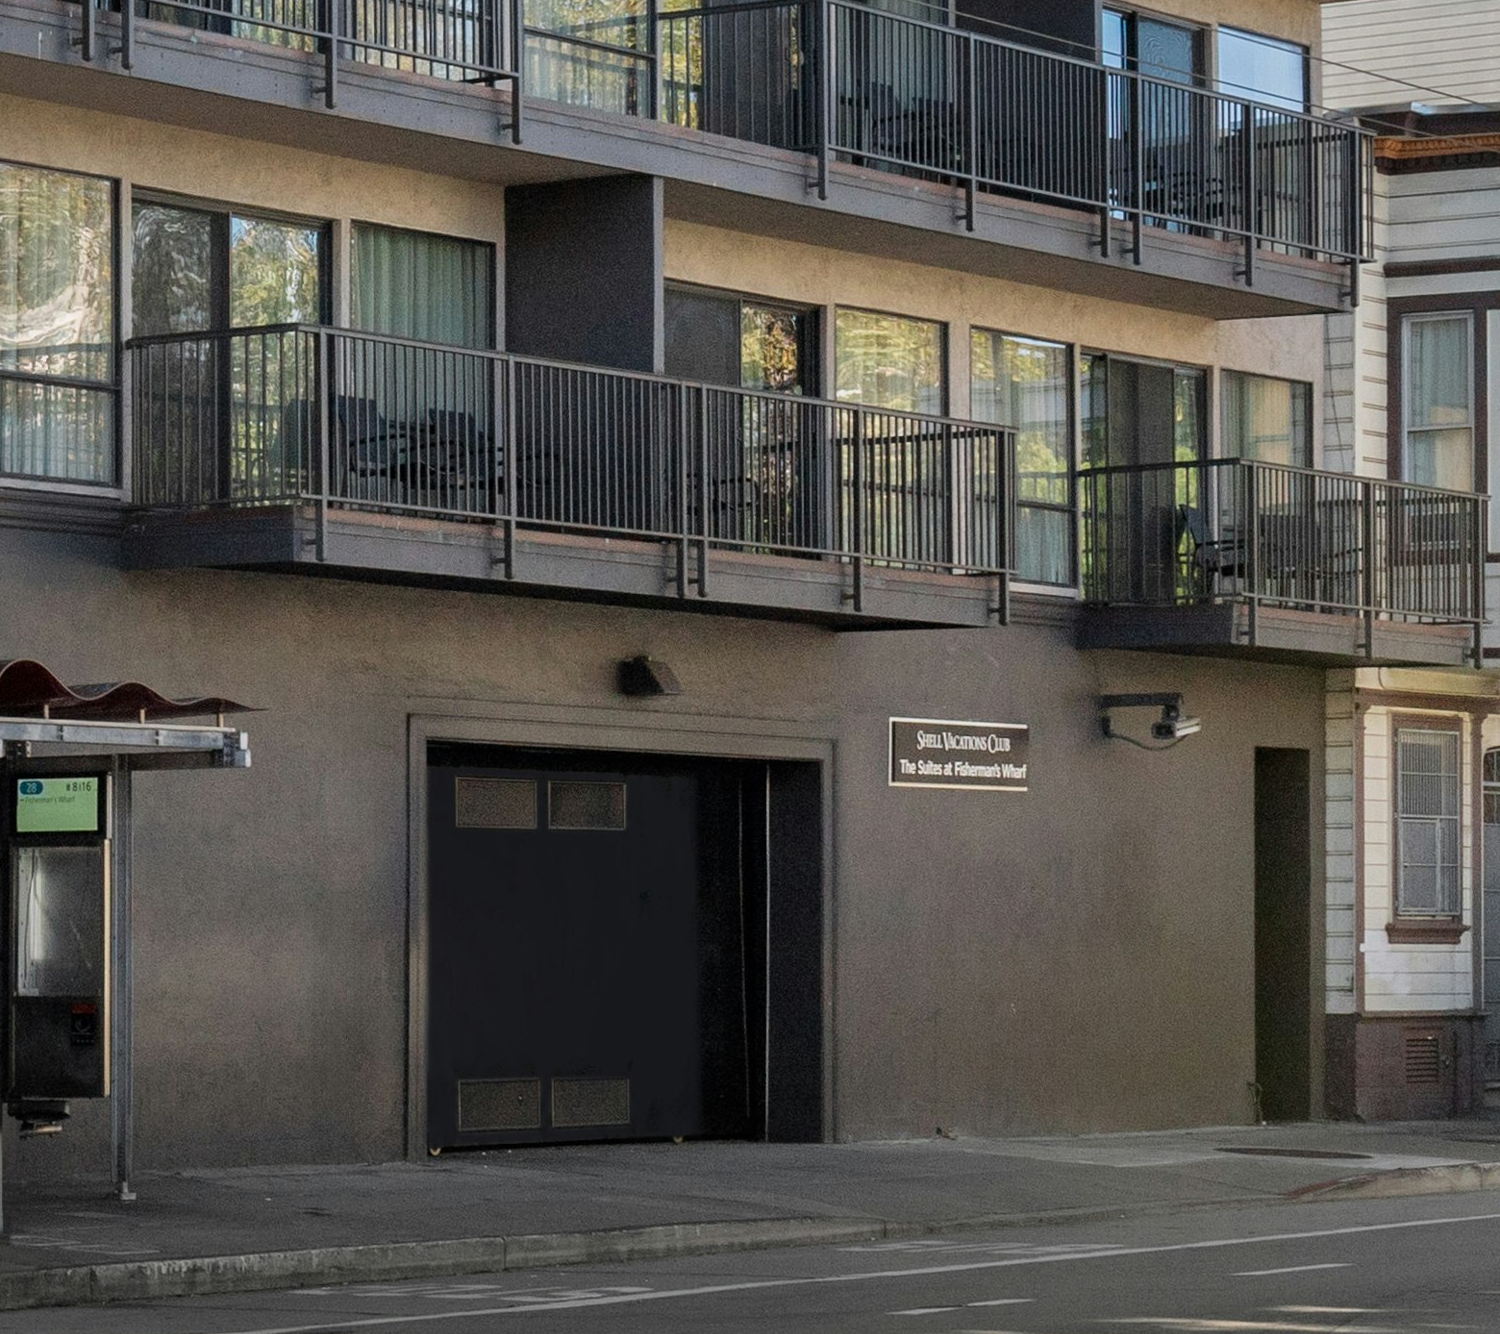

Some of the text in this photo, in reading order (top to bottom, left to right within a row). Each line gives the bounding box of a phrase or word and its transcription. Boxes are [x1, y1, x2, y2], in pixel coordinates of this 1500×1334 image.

[916, 730, 1011, 754] SHELL VACATIONS CLUB
[900, 759, 1027, 779] The Suites at Fisherman's Wharf
[26, 783, 37, 793] 28
